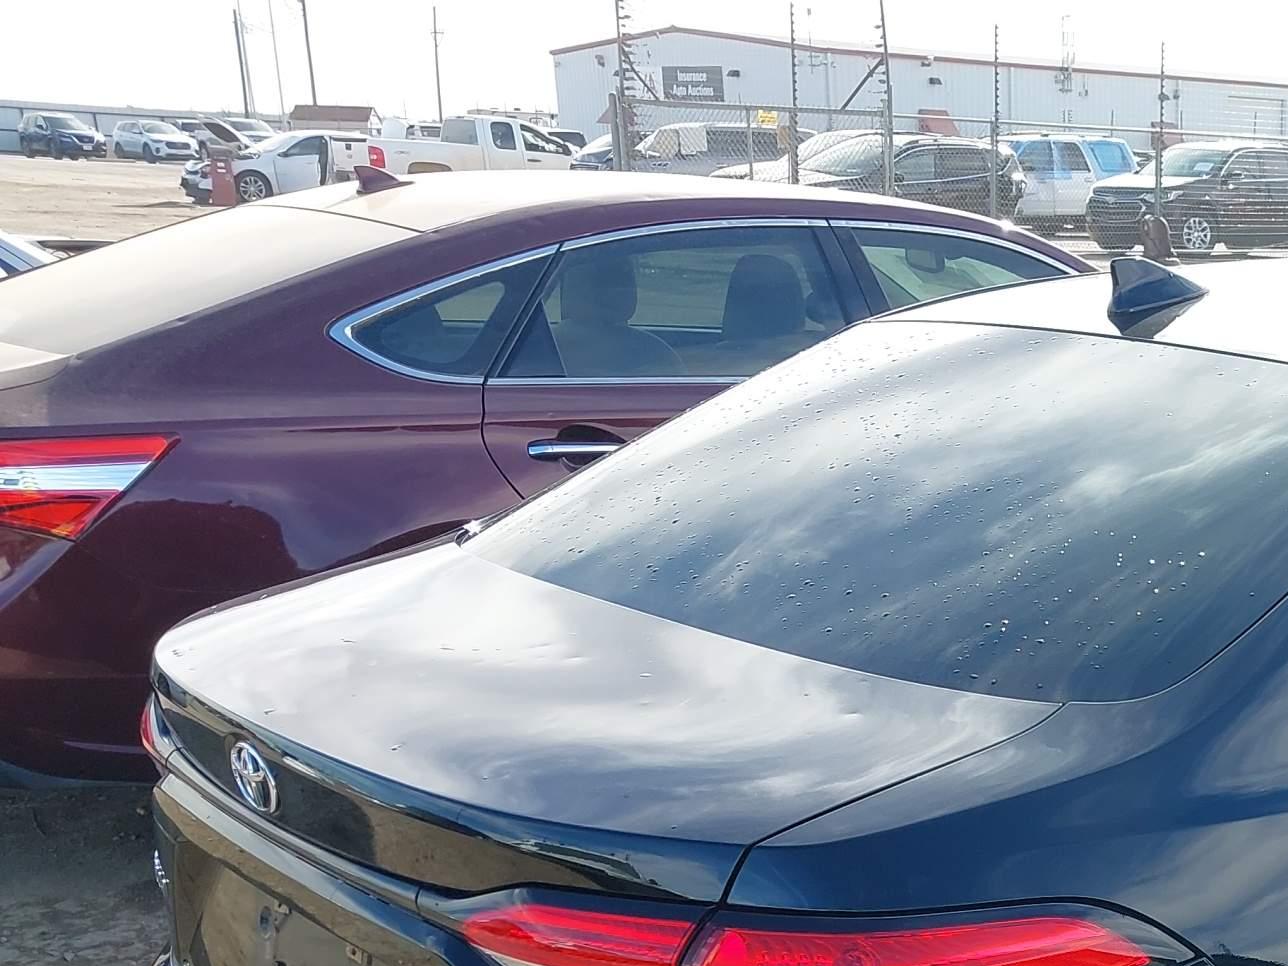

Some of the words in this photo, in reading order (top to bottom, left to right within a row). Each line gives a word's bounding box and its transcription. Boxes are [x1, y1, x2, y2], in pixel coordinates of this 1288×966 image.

[677, 69, 707, 82] Insurance
[672, 84, 687, 96] Auto
[687, 84, 714, 96] Auctions
